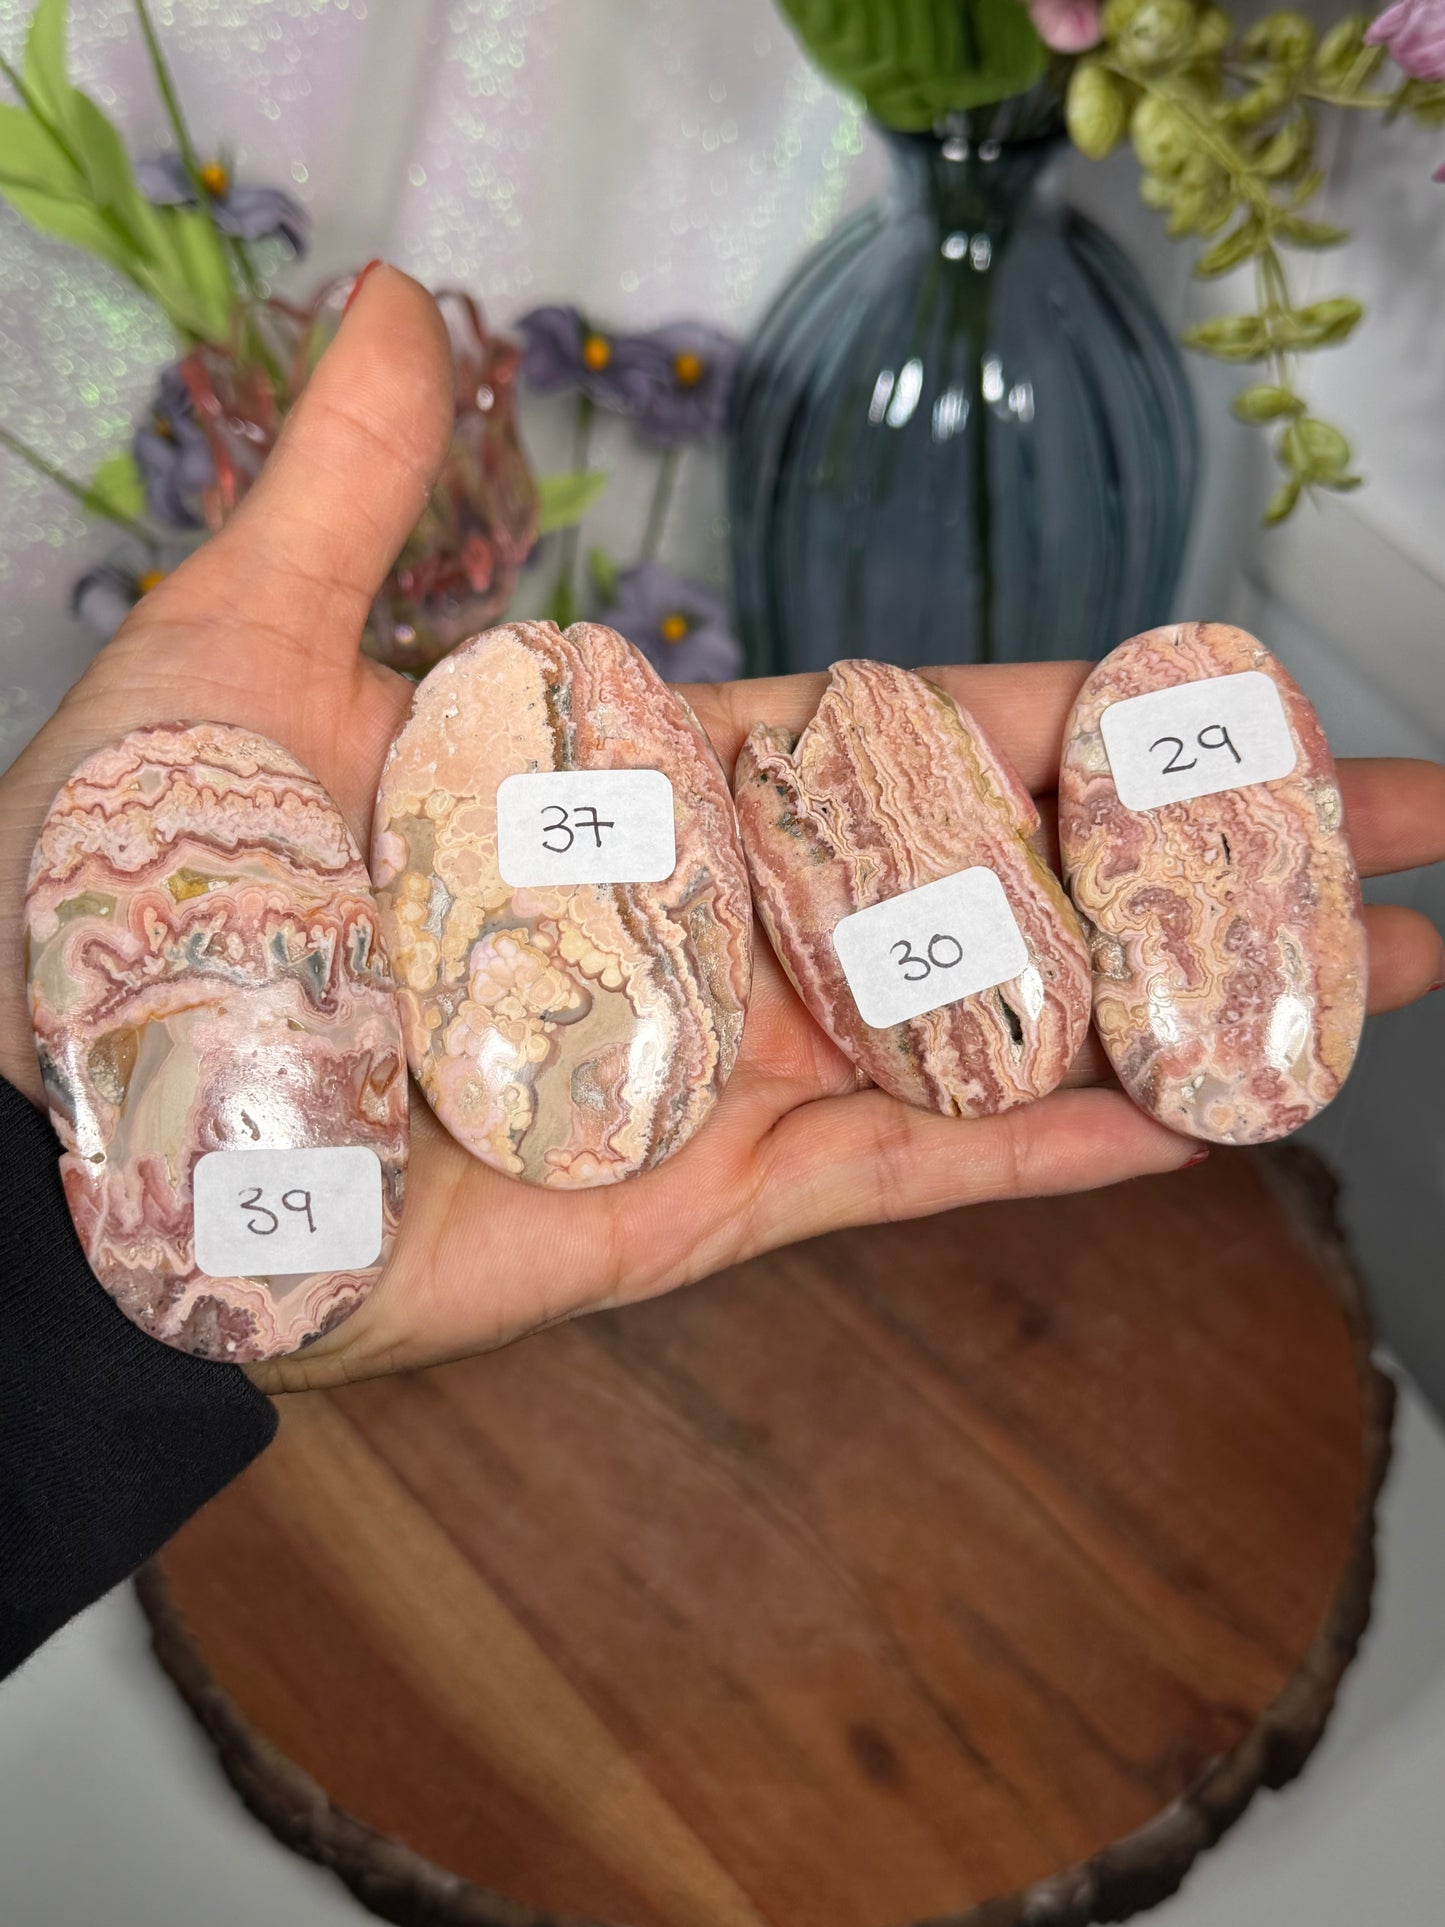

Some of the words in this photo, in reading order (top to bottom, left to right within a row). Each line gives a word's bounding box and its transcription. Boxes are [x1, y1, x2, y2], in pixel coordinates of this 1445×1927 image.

[1149, 724, 1242, 775] 29
[541, 805, 615, 853] 37
[890, 933, 964, 982] 30
[239, 1187, 317, 1235] 39
